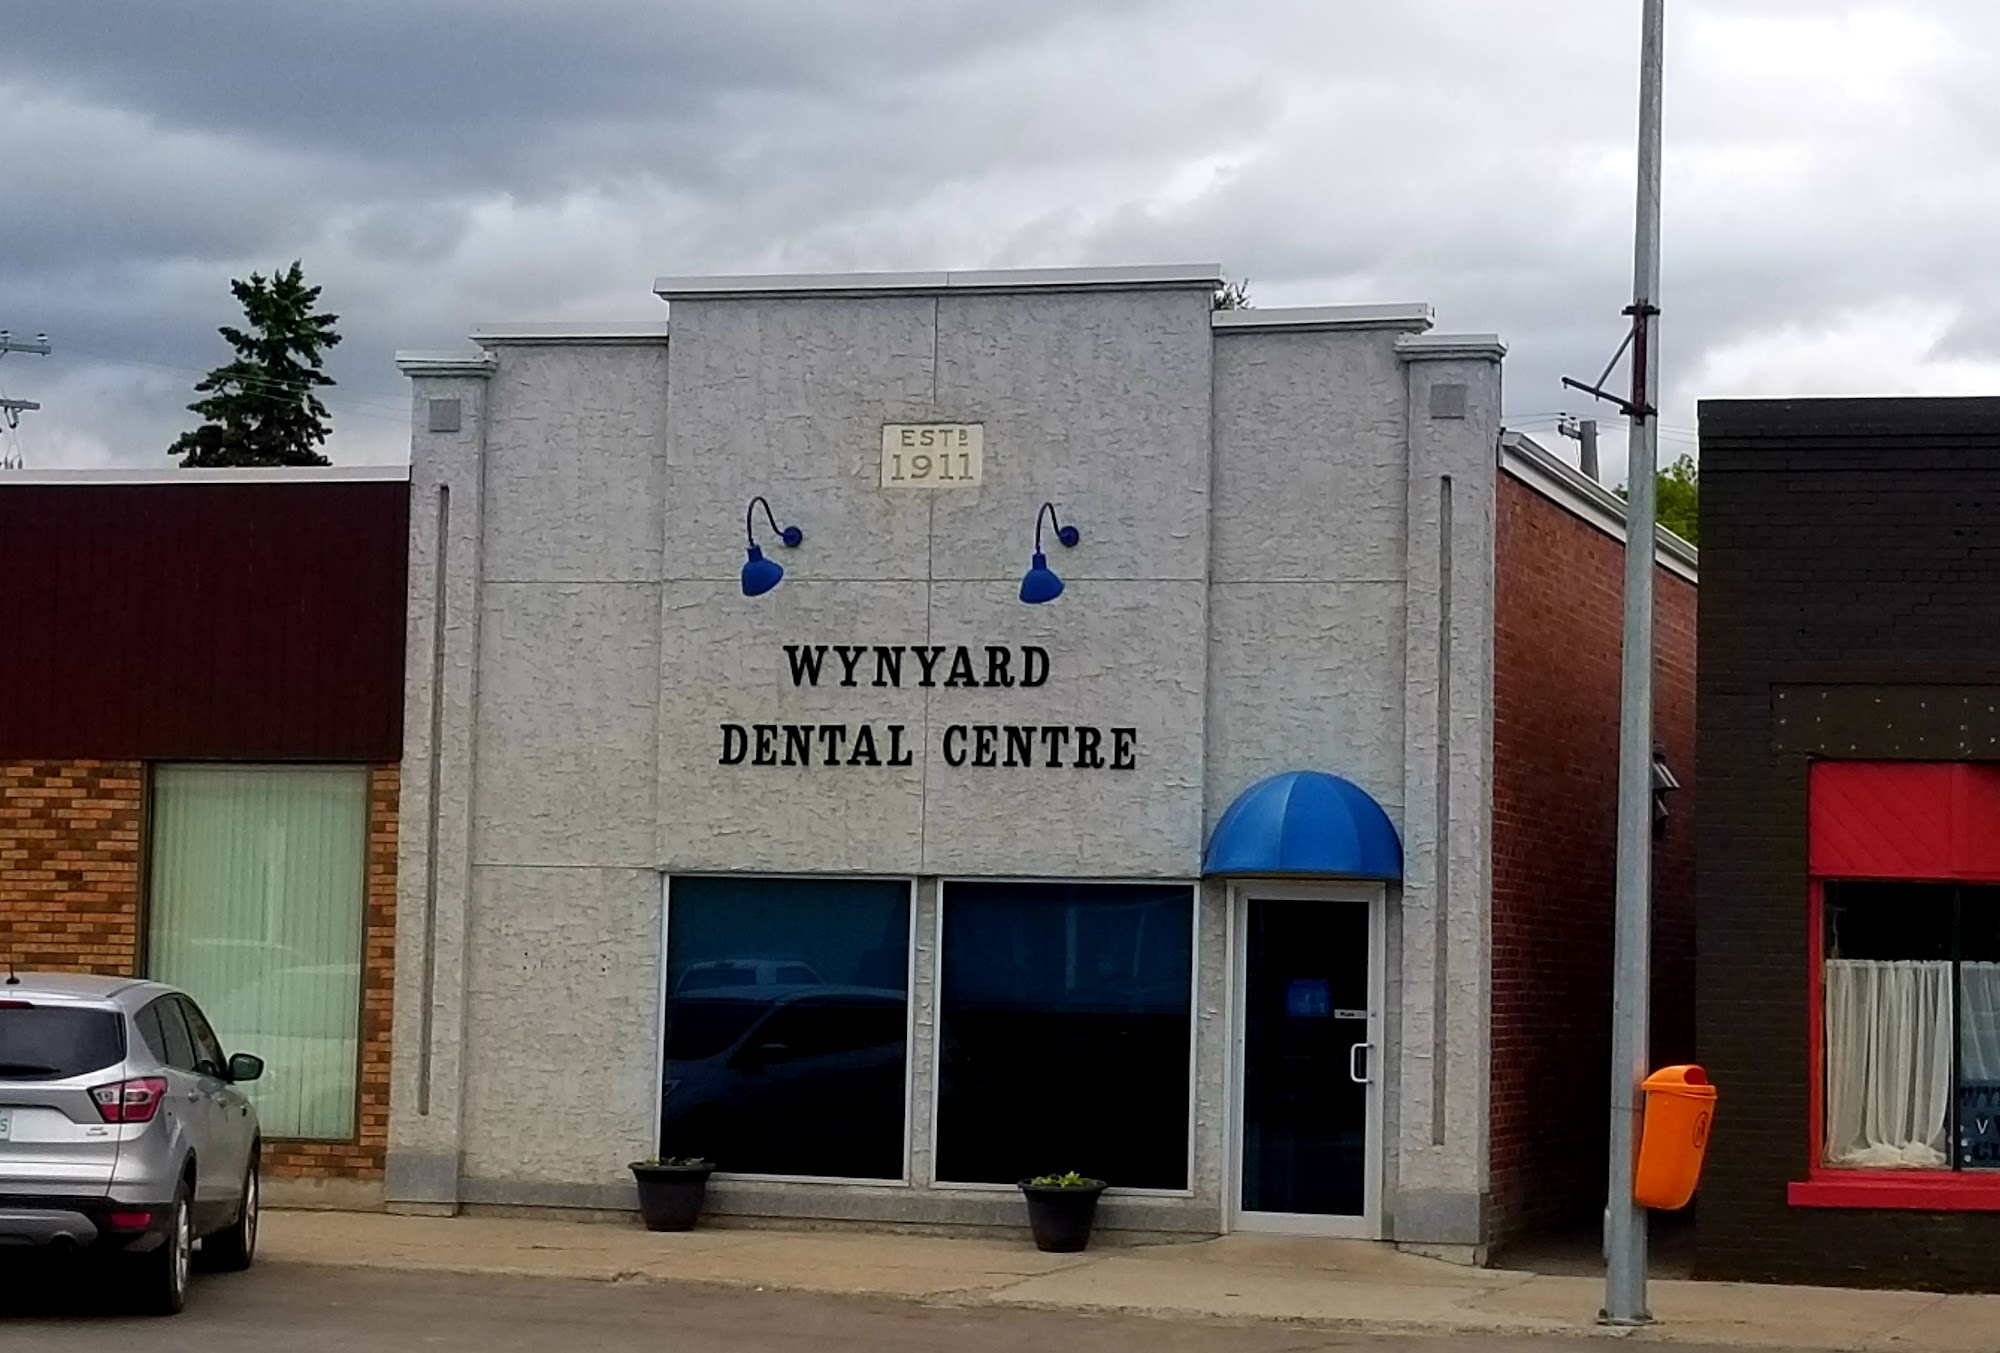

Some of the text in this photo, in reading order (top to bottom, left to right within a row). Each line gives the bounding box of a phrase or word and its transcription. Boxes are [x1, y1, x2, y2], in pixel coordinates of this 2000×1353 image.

[891, 453, 974, 481] 1911
[783, 645, 1050, 687] WYNYARD
[719, 724, 1137, 770] DENTAL CENTRE
